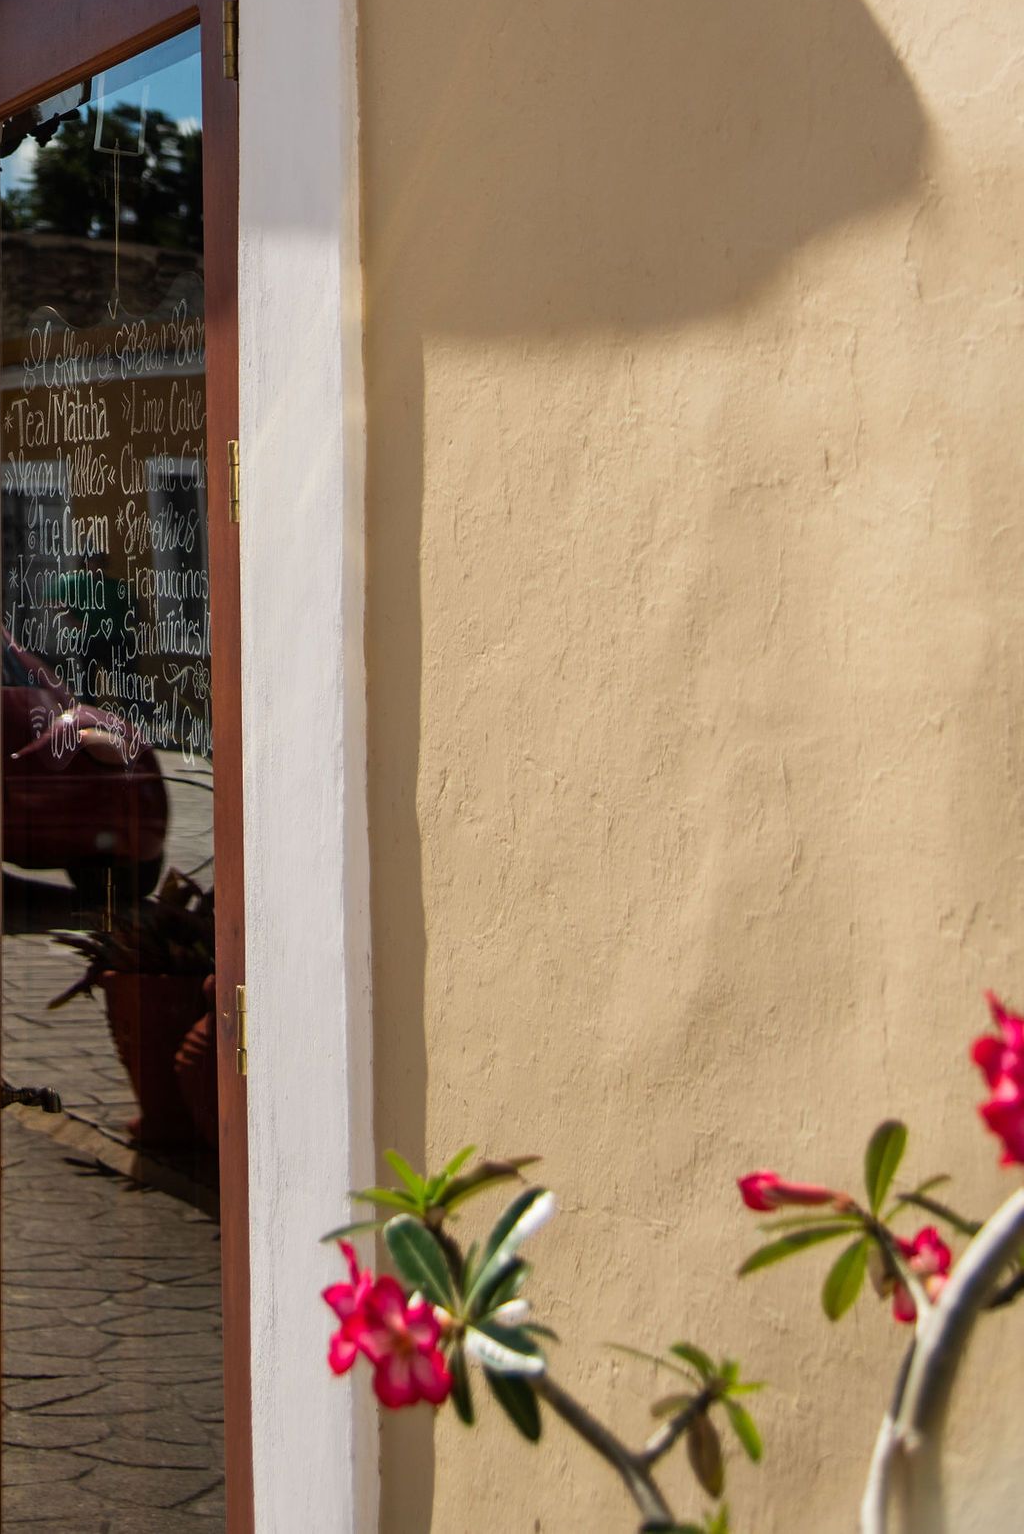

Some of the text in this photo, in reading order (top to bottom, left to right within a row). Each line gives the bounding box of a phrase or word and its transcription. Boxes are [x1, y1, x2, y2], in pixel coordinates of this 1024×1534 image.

[130, 380, 166, 437] Lime
[16, 553, 107, 611] Kombucha
[8, 600, 49, 656] Local
[64, 644, 159, 704] Air Conditioner
